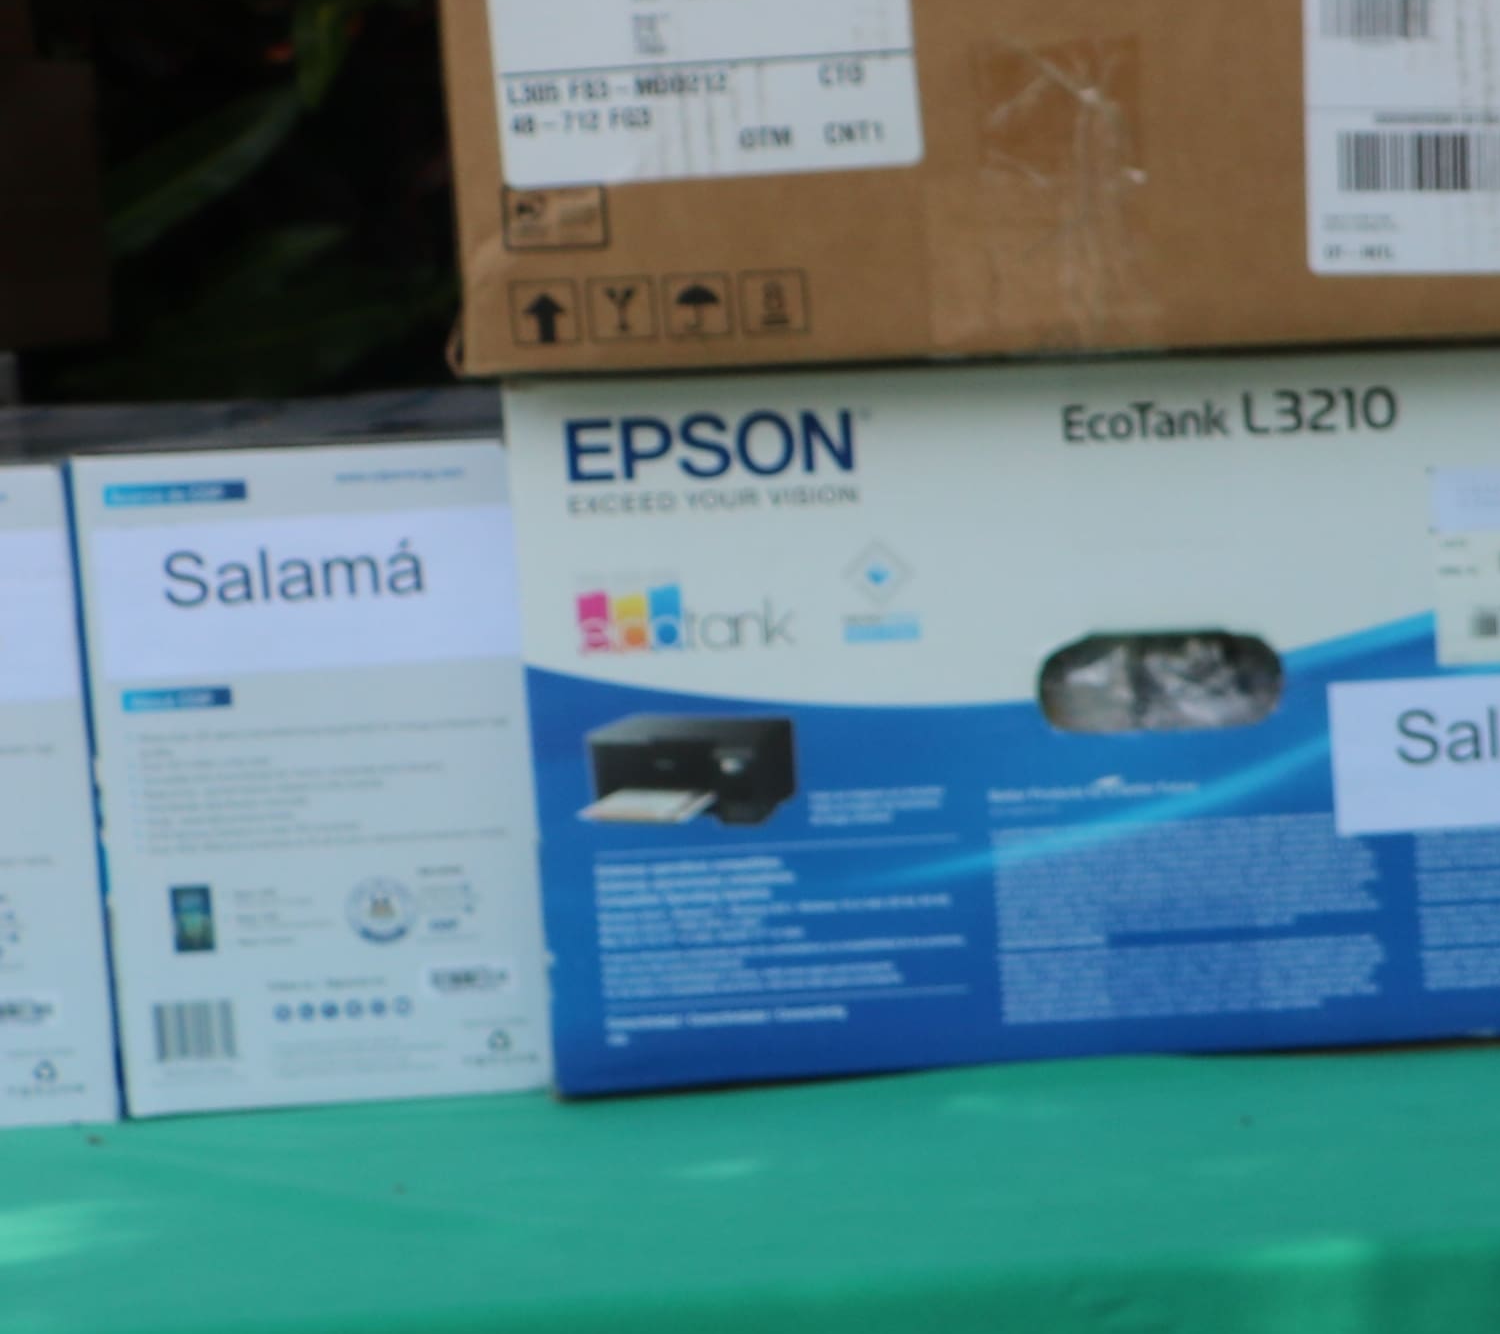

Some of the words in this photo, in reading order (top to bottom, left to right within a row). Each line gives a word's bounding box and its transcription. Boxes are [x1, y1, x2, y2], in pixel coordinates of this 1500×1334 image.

[564, 408, 857, 483] EPSON
[1061, 399, 1230, 445] EcoTank
[1241, 385, 1400, 437] L3210
[568, 489, 677, 517] EXCEED
[686, 486, 759, 511] YOUR
[767, 484, 861, 509] VISION
[162, 537, 427, 609] Salamá
